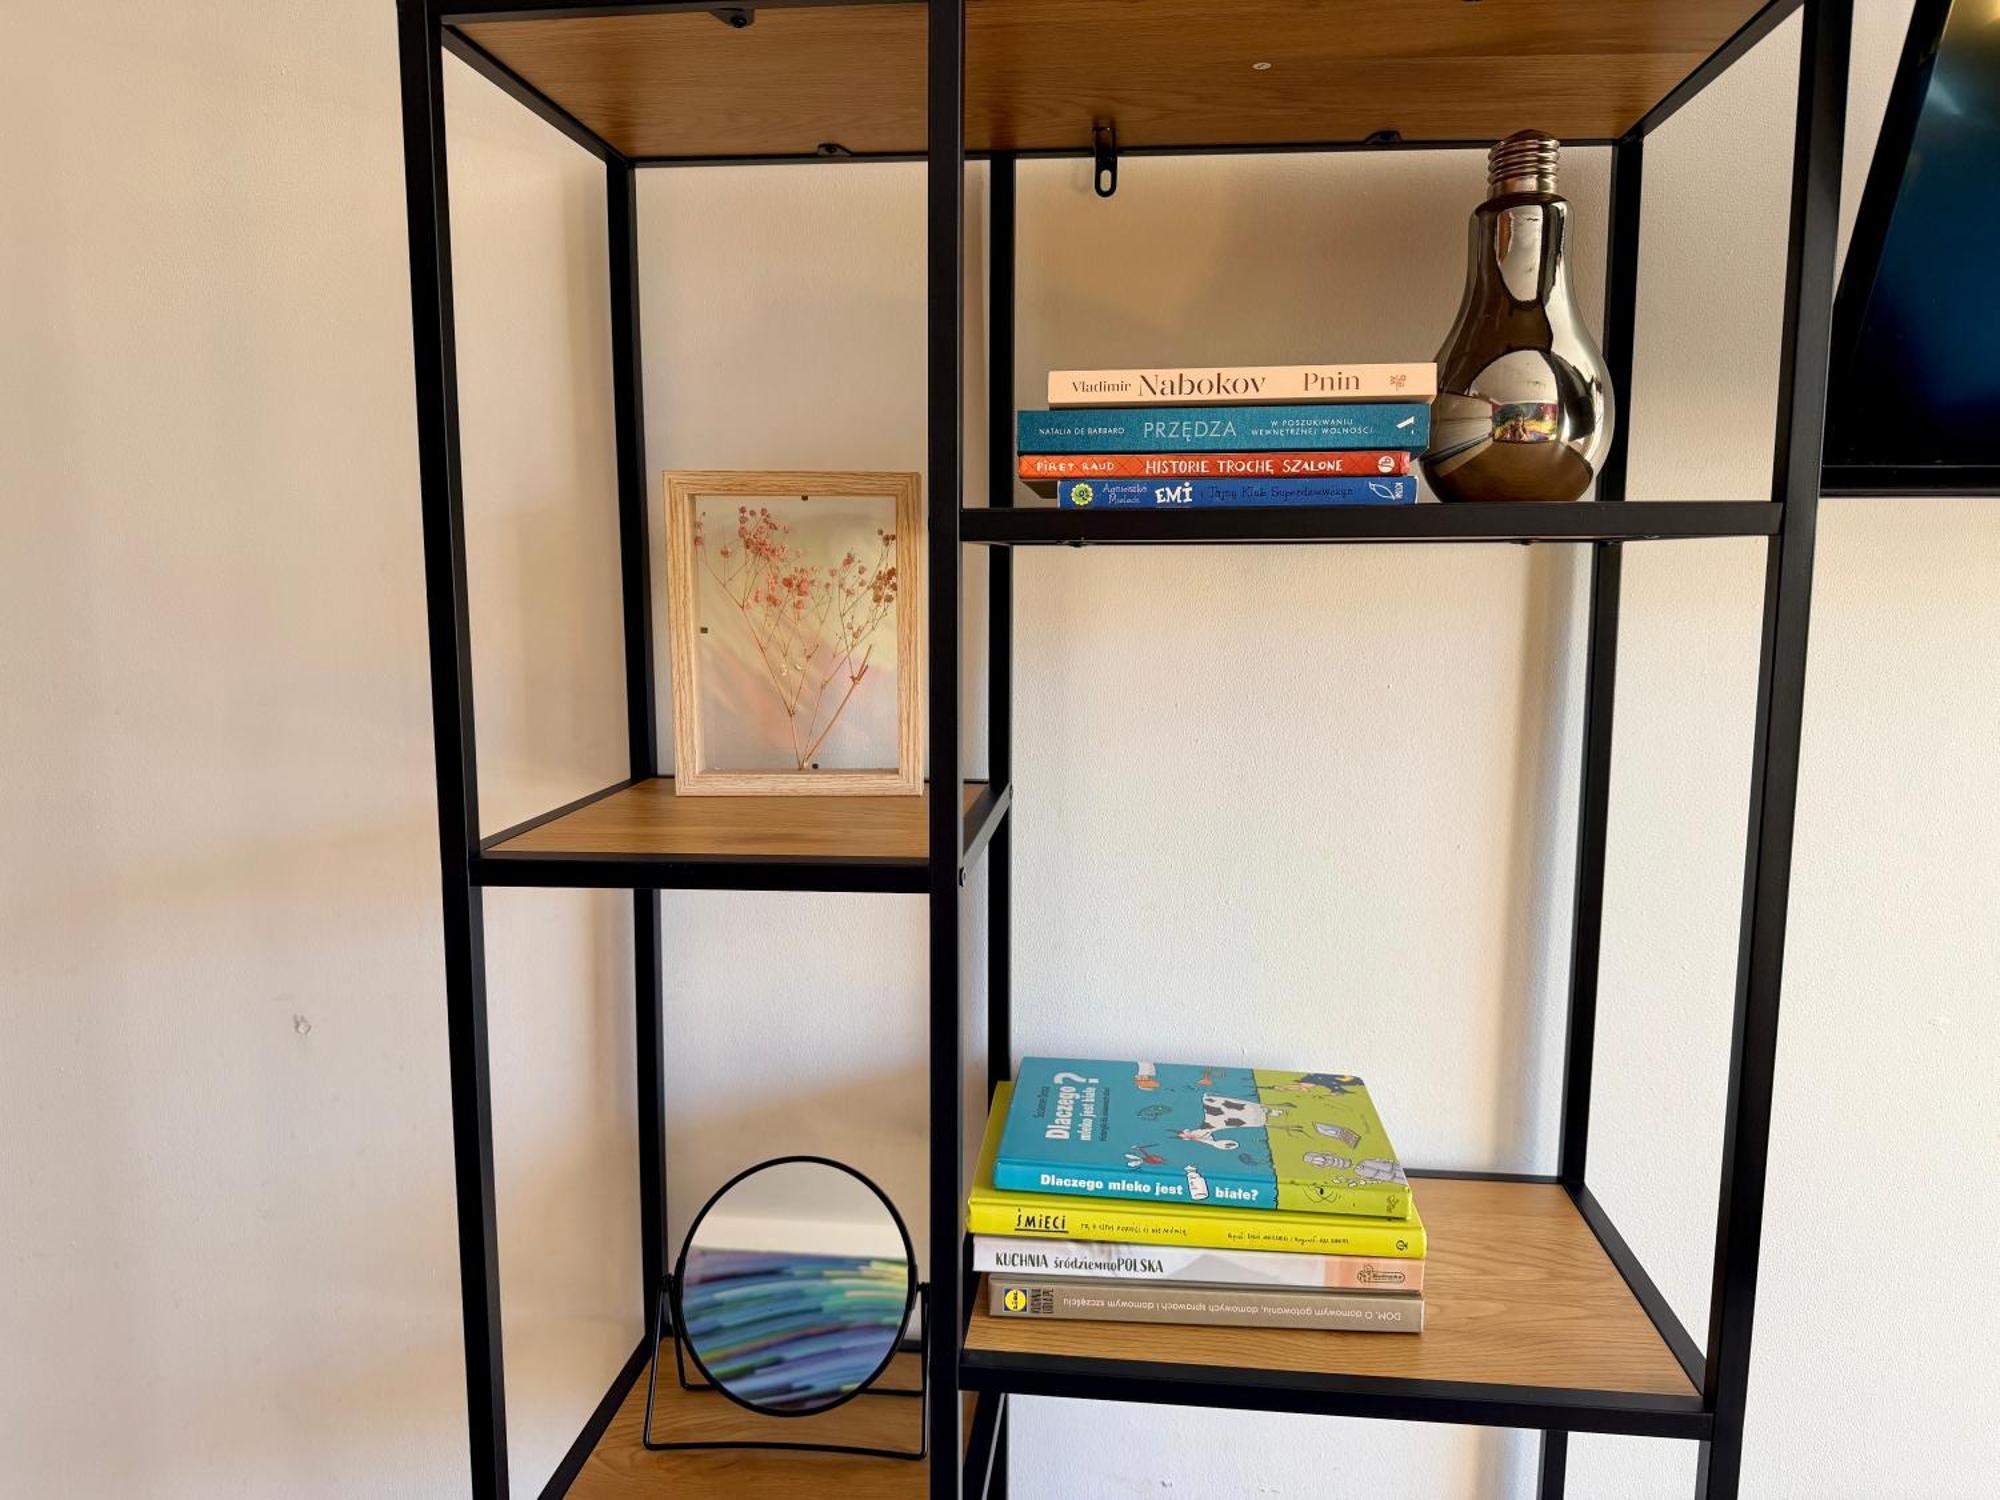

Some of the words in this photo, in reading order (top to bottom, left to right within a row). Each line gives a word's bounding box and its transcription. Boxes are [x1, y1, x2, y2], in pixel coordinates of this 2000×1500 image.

[1072, 381, 1132, 393] Vladimir
[1137, 373, 1266, 396] Nabokov
[1303, 371, 1360, 392] Pnin
[1271, 419, 1278, 427] W
[1281, 418, 1354, 427] POSZUKIWANIU
[1039, 427, 1072, 436] NATALIA
[1074, 427, 1085, 435] DE
[1143, 420, 1237, 442] PRZĘDZA
[1251, 427, 1317, 437] WEWNĘTRZNEJ
[1321, 425, 1374, 436] WOLNOŚCI
[1036, 460, 1075, 472] PIRET
[1082, 461, 1116, 471] RAUD
[1145, 460, 1210, 474] HISTORIE
[1217, 459, 1274, 474] TROCHĘ
[1282, 459, 1344, 473] SZALONE
[1045, 1086, 1080, 1140] Dlaczego
[1040, 1174, 1104, 1192] Dlaczego
[1108, 1179, 1151, 1193] mleko
[1155, 1181, 1183, 1196] jest
[1215, 1187, 1259, 1200] białe?
[995, 1252, 1049, 1268] KUCHNIA
[1053, 1256, 1164, 1273] śródziemnoPOLSKA
[1063, 1298, 1105, 1308] szczęściu
[1107, 1299, 1154, 1310] domowym
[1162, 1301, 1207, 1312] sprawach
[1208, 1304, 1259, 1314] domowych
[1261, 1305, 1313, 1315] gotowaniu,
[1314, 1308, 1362, 1318] domowym
[1364, 1311, 1373, 1319] O
[1374, 1312, 1401, 1320] DOM.
